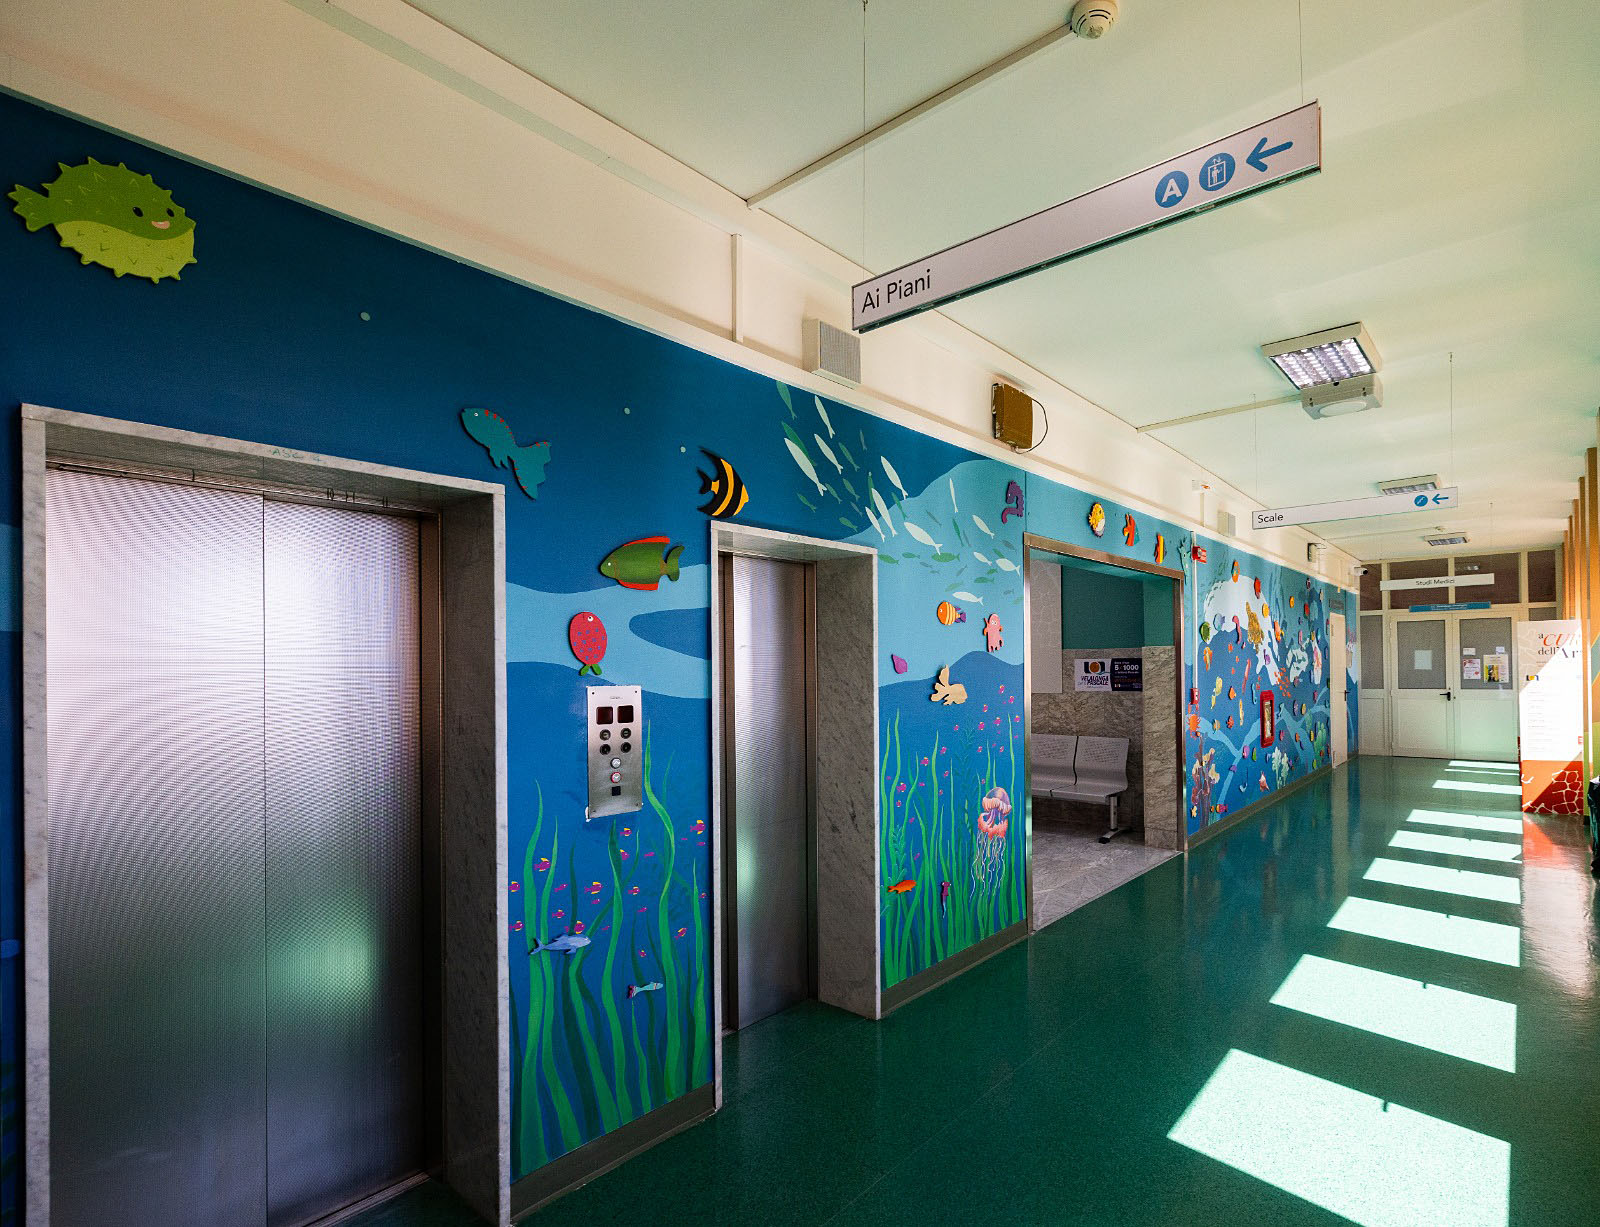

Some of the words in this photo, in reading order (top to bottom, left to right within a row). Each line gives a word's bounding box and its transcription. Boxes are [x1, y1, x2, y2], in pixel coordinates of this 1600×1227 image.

[1161, 178, 1183, 203] A
[861, 288, 880, 313] Ai
[887, 268, 931, 303] Piani
[1257, 512, 1284, 524] Scale
